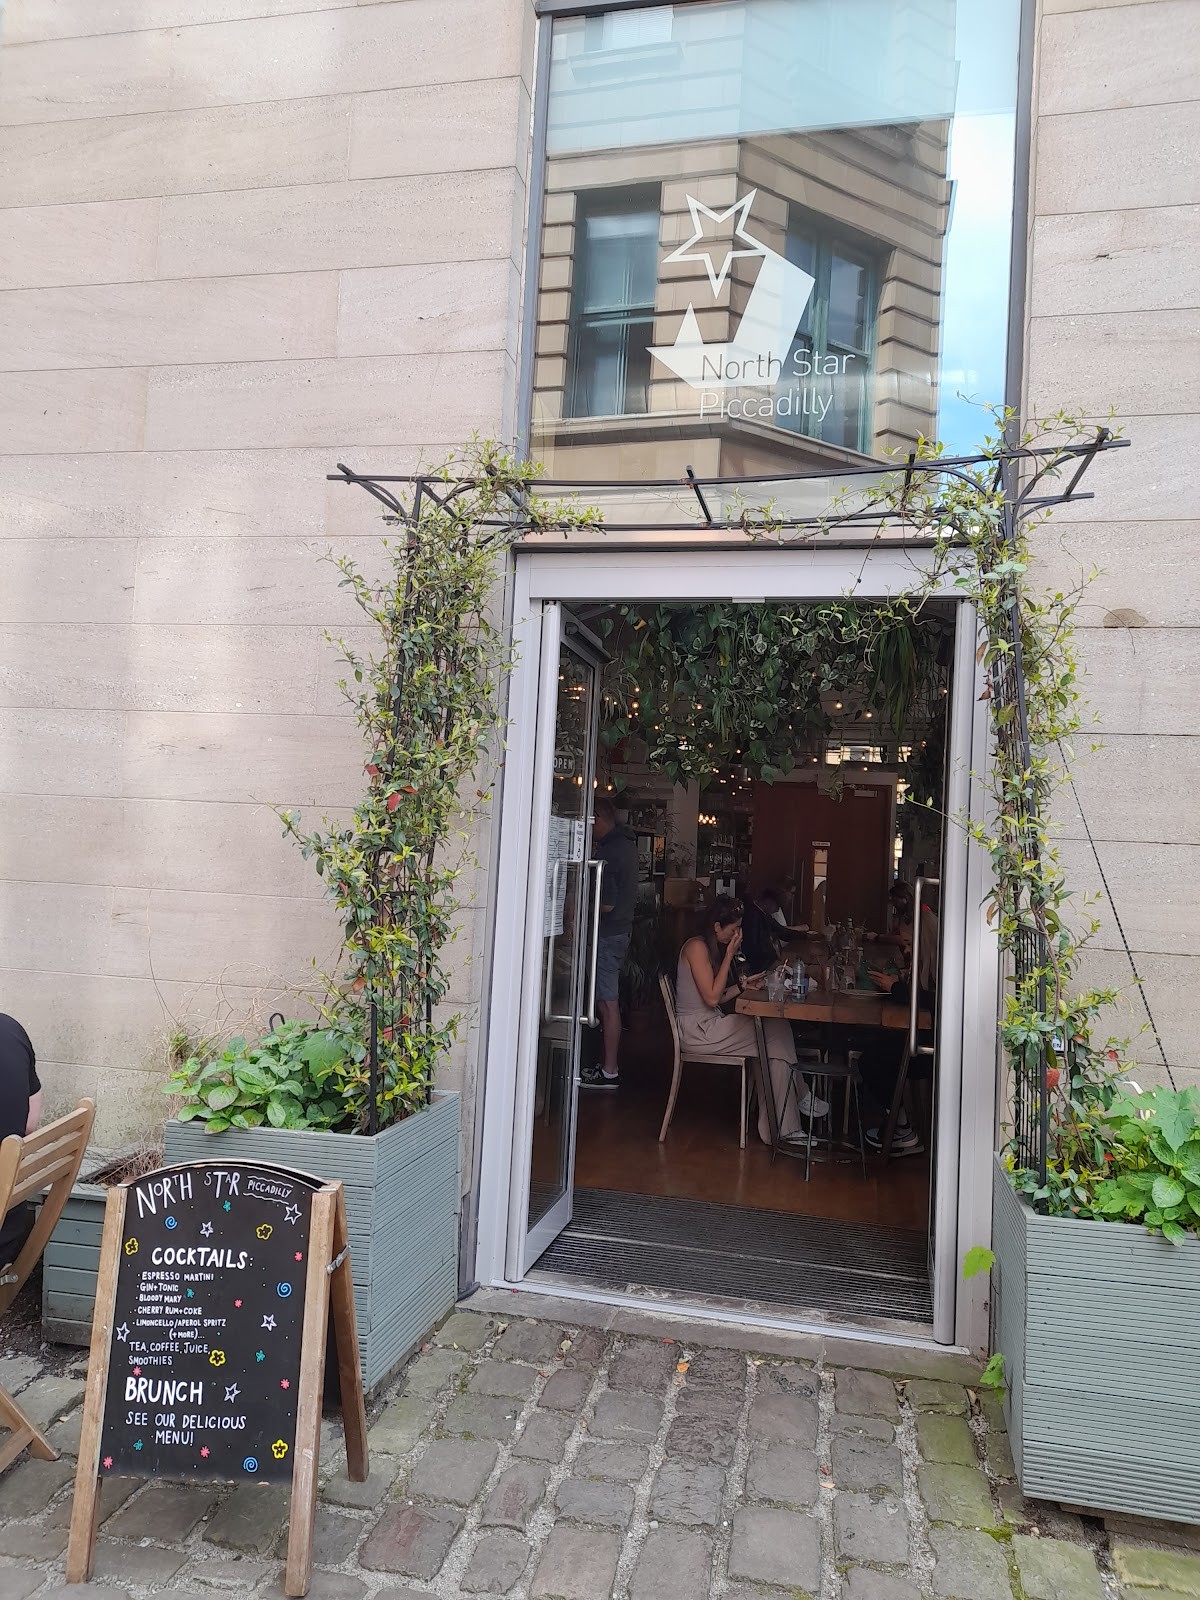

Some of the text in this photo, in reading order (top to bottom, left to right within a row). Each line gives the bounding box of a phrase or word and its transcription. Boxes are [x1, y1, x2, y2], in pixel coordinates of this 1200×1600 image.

[701, 348, 856, 381] North Star
[699, 387, 833, 422] Piccadilly
[135, 1171, 293, 1218] NORTH STAR PICCADILLY
[151, 1247, 254, 1270] COCKTAILS:
[141, 1271, 214, 1281] ESPRESSO MARTINI
[139, 1294, 182, 1303] BLOODY MARY
[137, 1306, 163, 1314] CHERRY
[203, 1319, 226, 1327] SPRITZ
[128, 1356, 173, 1365] SMOOTHIES
[125, 1376, 203, 1405] BRUNCH
[125, 1411, 247, 1429] SEE OUR DELICIOUS
[155, 1430, 194, 1446] MENU!
